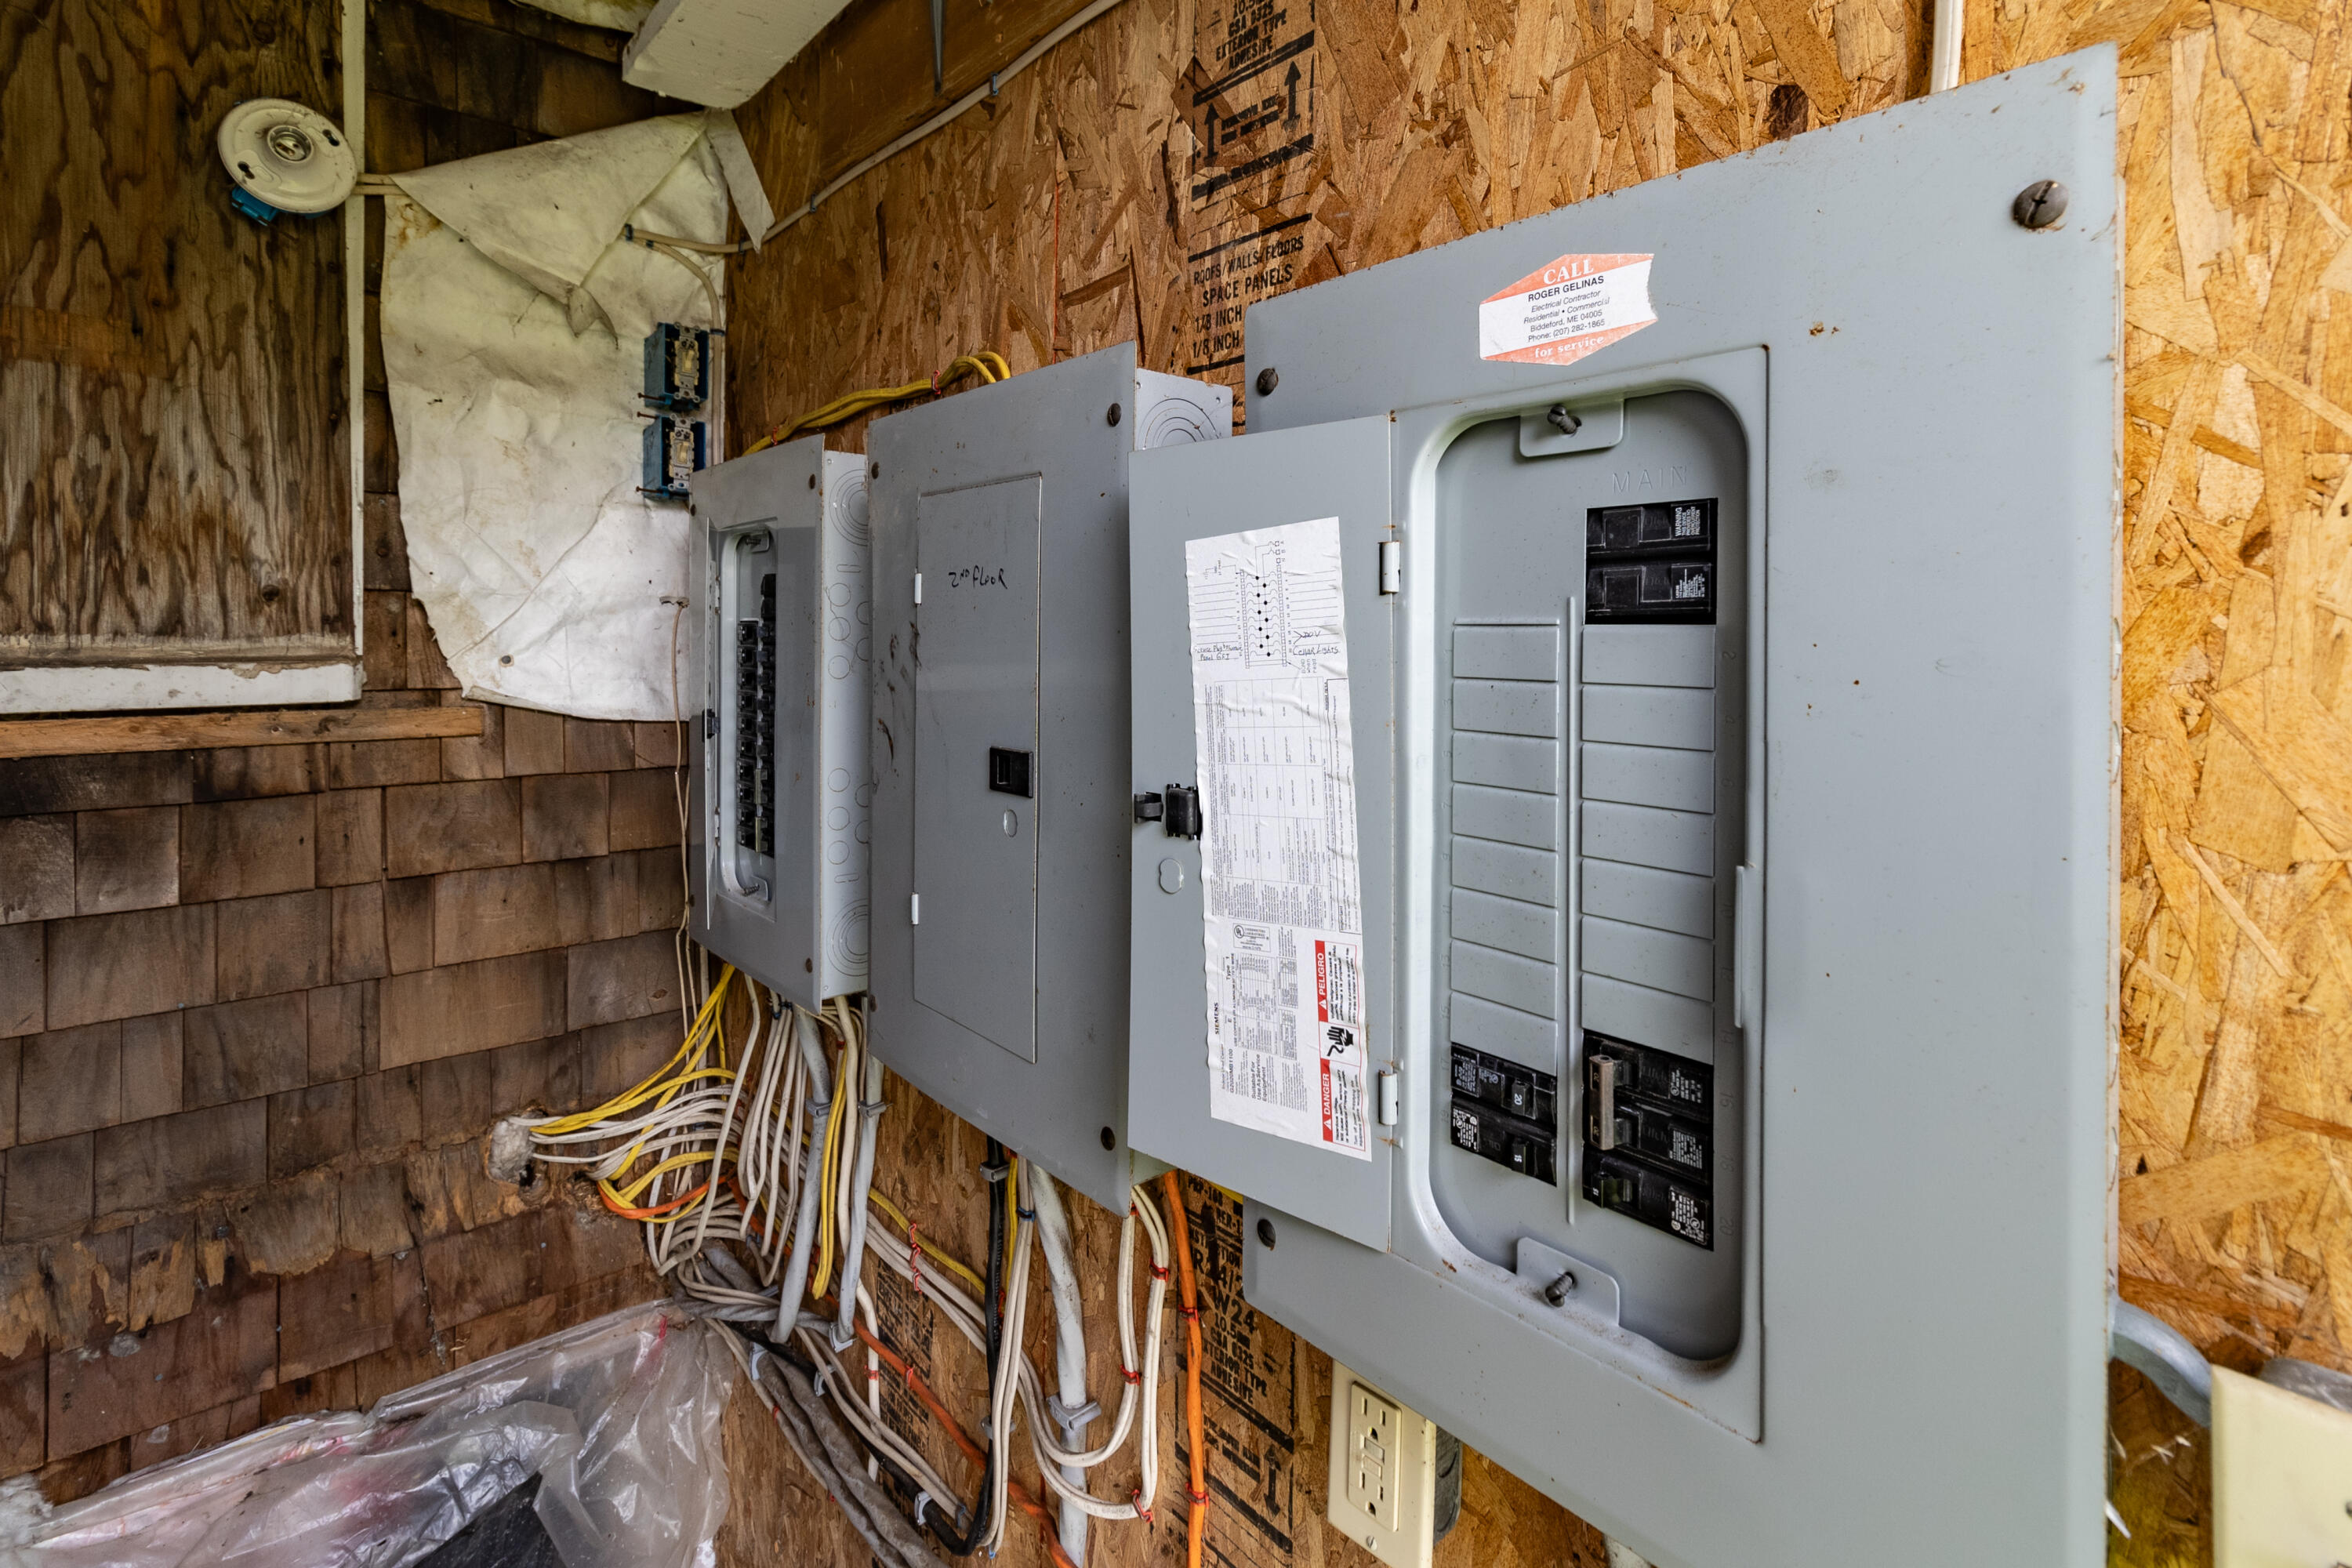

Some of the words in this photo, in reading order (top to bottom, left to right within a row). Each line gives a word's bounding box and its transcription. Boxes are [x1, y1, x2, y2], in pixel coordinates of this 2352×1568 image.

[1216, 26, 1258, 61] EXTERIOR
[1229, 35, 1272, 70] ADHESIVE
[1203, 280, 1240, 307] SPACE
[1244, 263, 1293, 294] PANELS
[1543, 259, 1594, 285] CALL
[1528, 285, 1560, 302] ROGER
[1563, 275, 1605, 293] GELINAS
[1531, 299, 1562, 313] Electrical
[1563, 290, 1602, 305] Contractor
[1195, 313, 1211, 334] 1/8
[1216, 304, 1243, 328] INCH
[1524, 309, 1559, 324] Residential
[1530, 318, 1566, 332] Biddeford,
[1567, 315, 1579, 325] ME
[1581, 310, 1602, 321] 04005
[1192, 338, 1209, 358] 1/8
[1213, 330, 1240, 352] INCH
[1528, 330, 1551, 343] Phone:
[1552, 326, 1570, 339] (207)
[1571, 319, 1606, 333] 282-1865
[1534, 347, 1552, 358] for
[1557, 336, 1606, 354] service
[1612, 465, 1687, 495] MAIN
[1317, 953, 1326, 996] PELIGRO
[1514, 1093, 1523, 1105] 20
[1514, 1154, 1523, 1163] 15
[1216, 1292, 1257, 1334] W24
[1203, 1340, 1240, 1374] XTERIOR
[1244, 1367, 1268, 1397] TYPE
[1210, 1360, 1254, 1404] ADHESIVE
